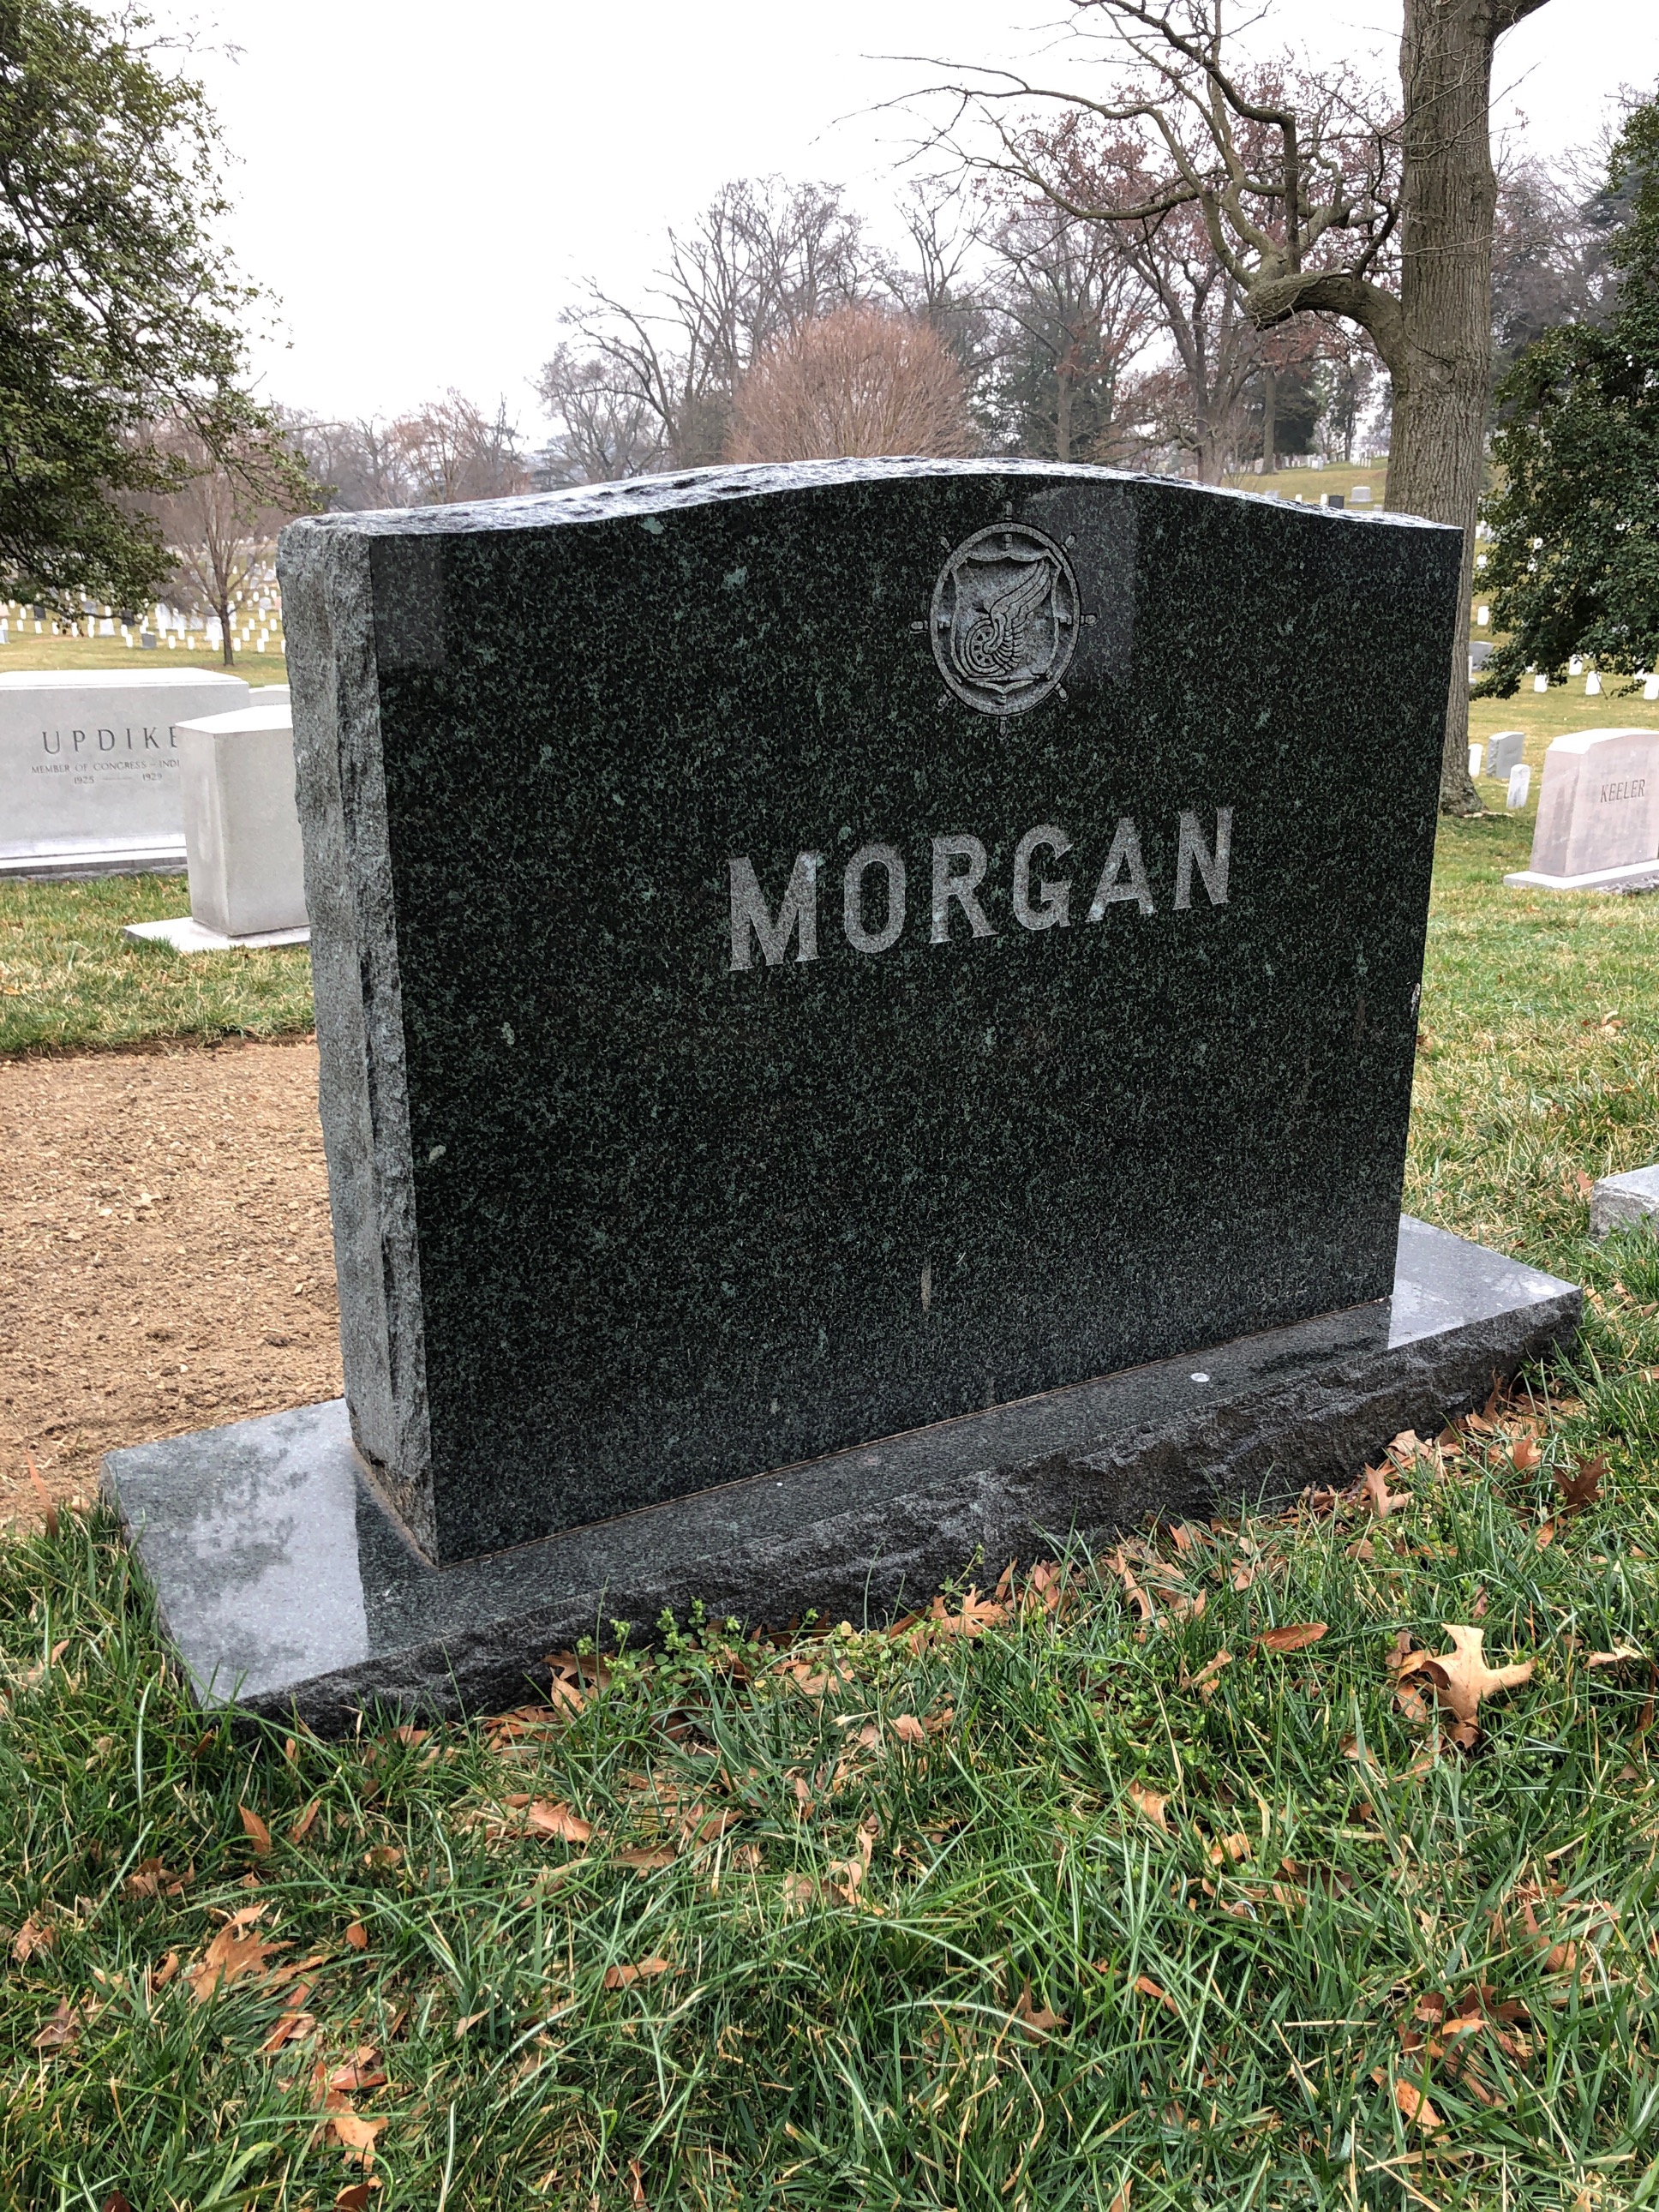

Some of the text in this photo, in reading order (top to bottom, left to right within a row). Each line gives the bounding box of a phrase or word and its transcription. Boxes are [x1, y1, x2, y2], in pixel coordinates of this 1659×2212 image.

[42, 727, 178, 755] UPDIKE
[31, 764, 70, 774] MEMBER
[75, 763, 87, 771] OF
[93, 761, 147, 771] CONGRESS
[74, 776, 95, 784] 1925
[1600, 779, 1645, 803] KEELER
[728, 806, 1234, 972] MORGAN
